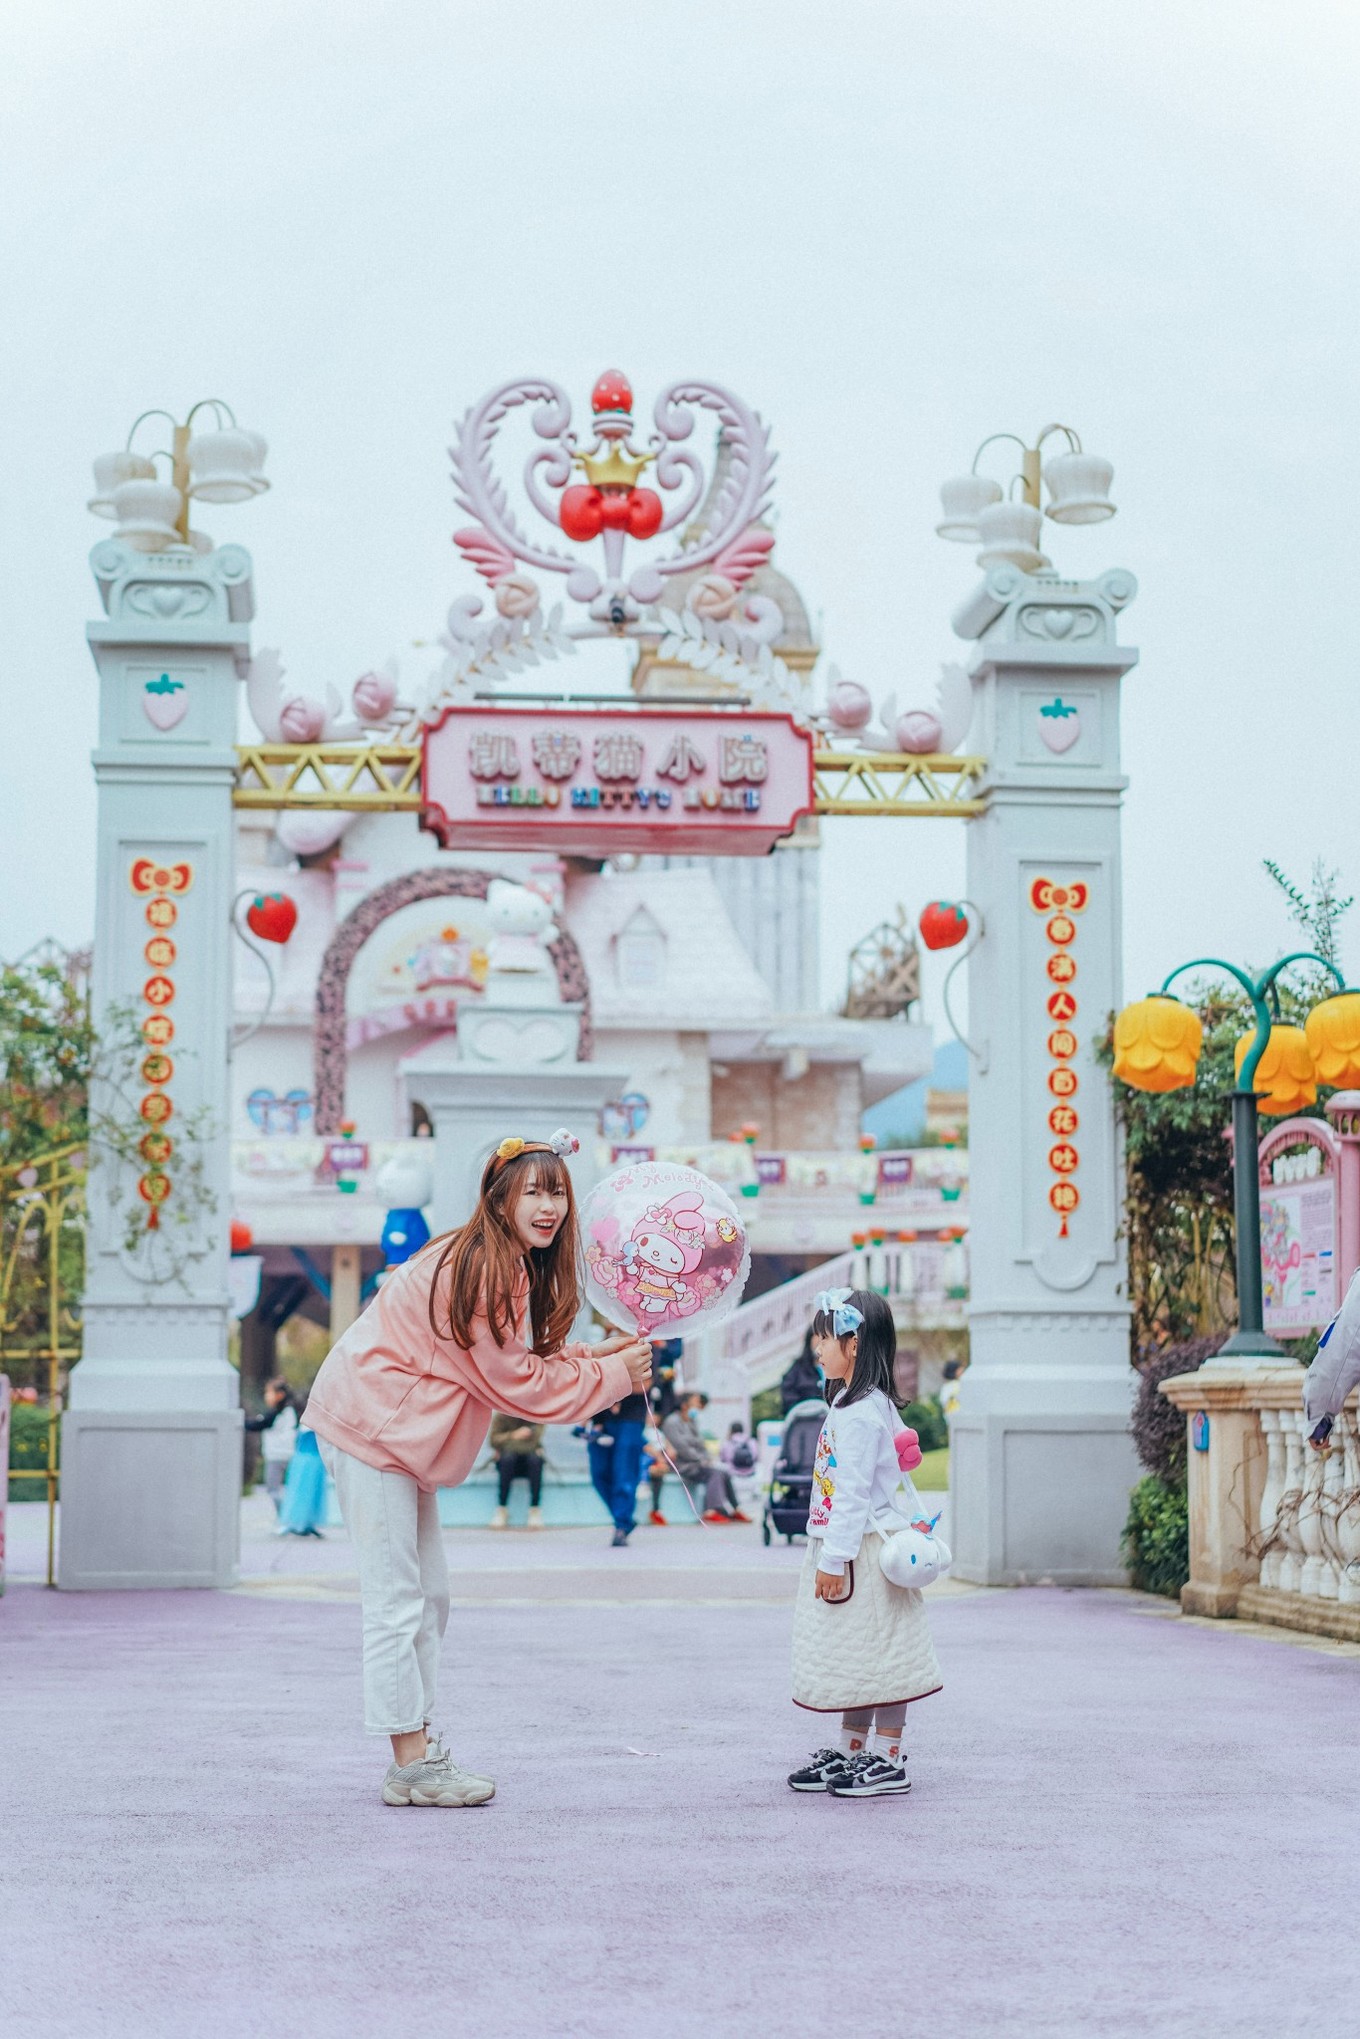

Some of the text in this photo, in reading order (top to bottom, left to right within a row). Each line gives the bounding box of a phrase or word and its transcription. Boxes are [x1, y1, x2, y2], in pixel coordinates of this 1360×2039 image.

[469, 732, 768, 784] 凯蒂猫小院
[476, 784, 560, 809] HELLO
[683, 785, 760, 812] HOME
[642, 1171, 705, 1190] Melody
